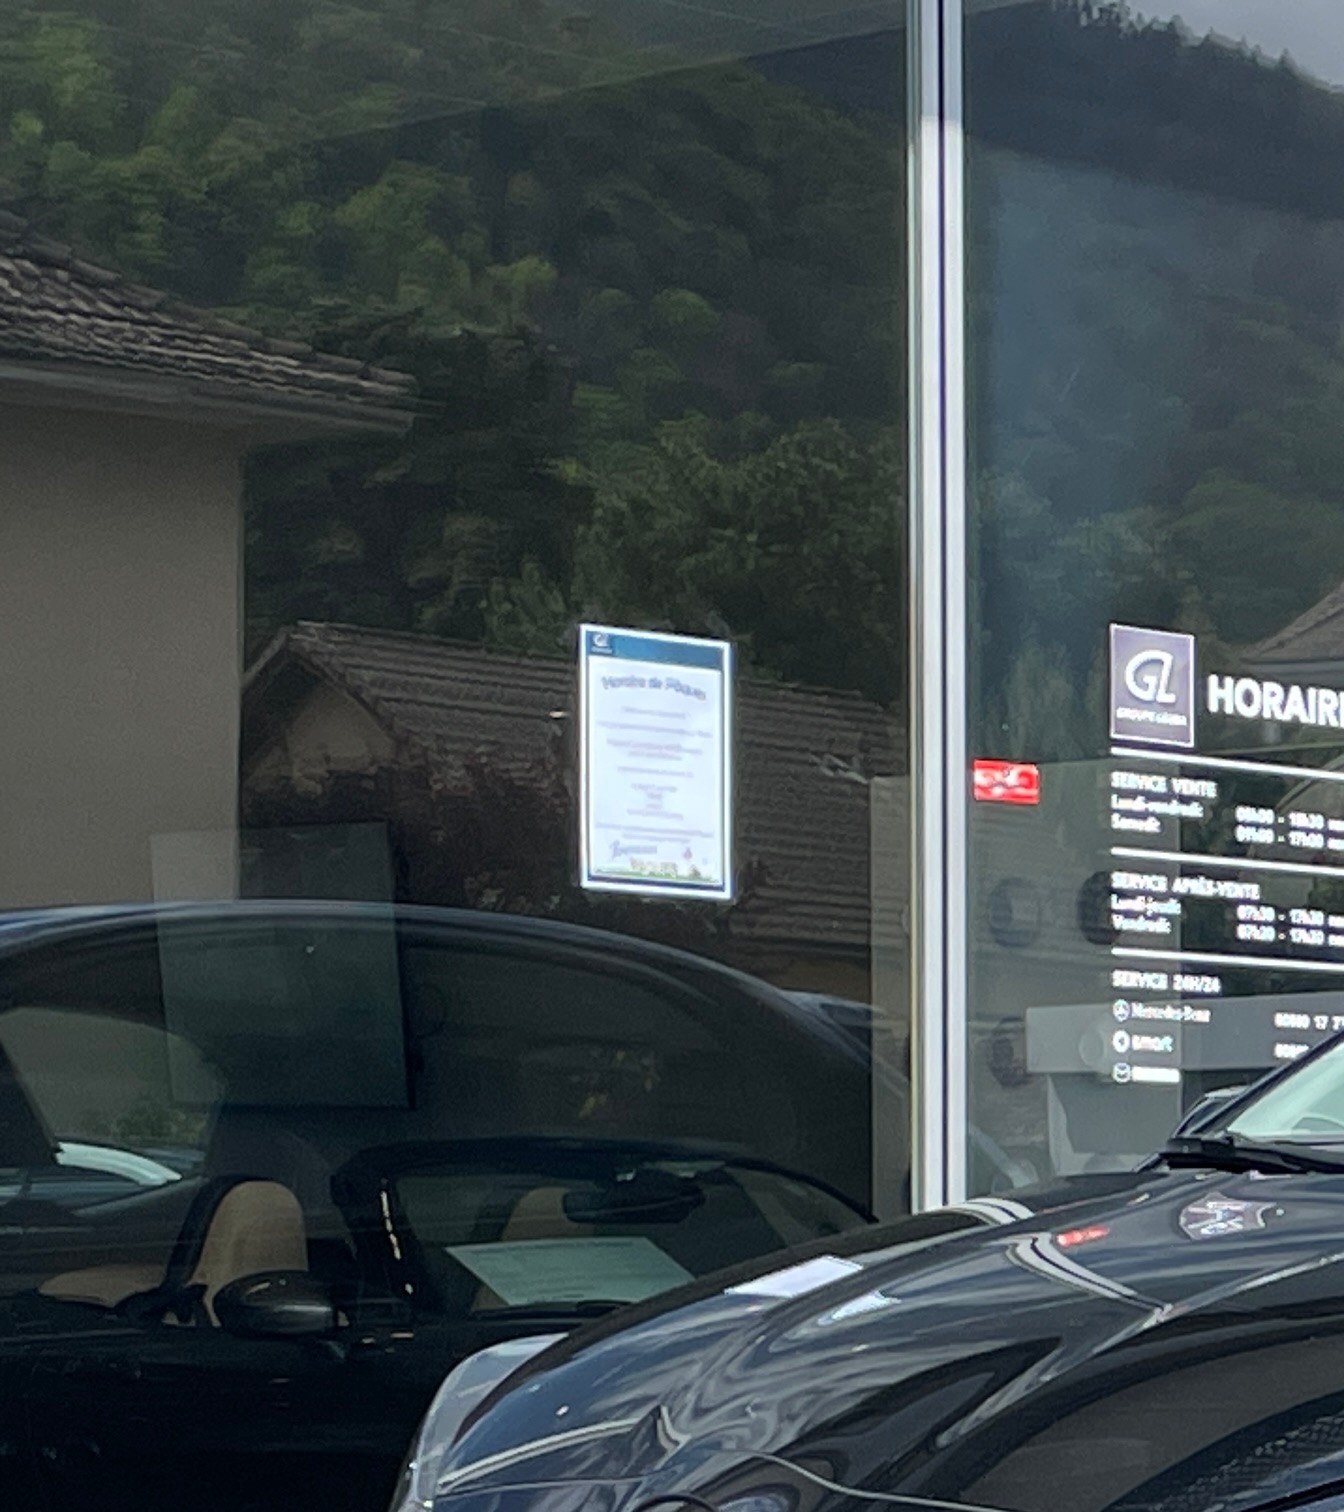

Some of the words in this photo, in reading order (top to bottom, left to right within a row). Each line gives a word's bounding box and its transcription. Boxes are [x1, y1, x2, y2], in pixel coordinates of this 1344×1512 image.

[1125, 649, 1176, 703] GL
[1110, 771, 1167, 793] SERVICE
[1170, 777, 1218, 799] VENTE
[1110, 871, 1168, 892] SERVICE
[1112, 969, 1168, 990] SERVICE
